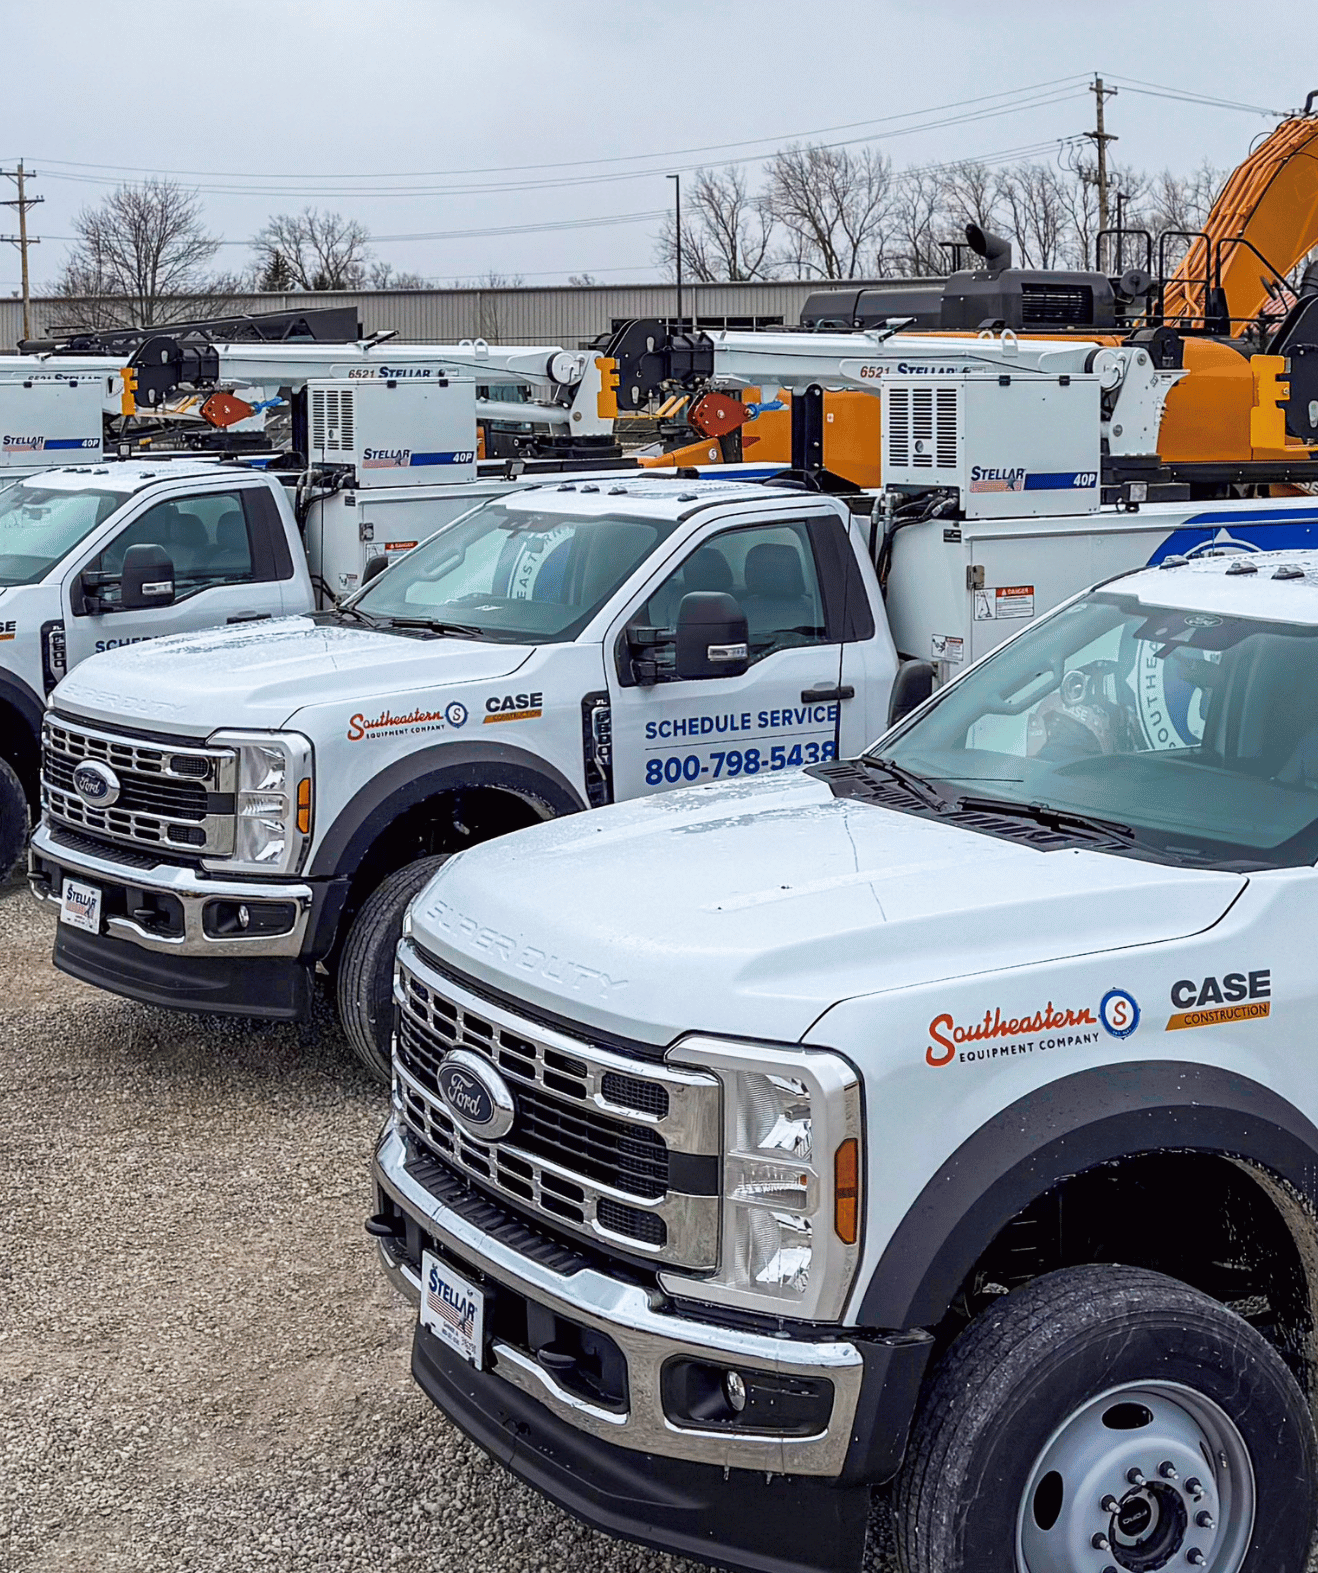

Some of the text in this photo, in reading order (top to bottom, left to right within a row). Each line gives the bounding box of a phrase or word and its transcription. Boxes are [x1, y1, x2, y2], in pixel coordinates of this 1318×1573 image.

[348, 366, 431, 378] 6521 STELLAR
[860, 365, 890, 378] 6521
[3, 435, 99, 449] STELLAR 40P
[363, 448, 473, 462] STELLAR 40P
[971, 466, 1095, 487] STELLAR 40P
[485, 692, 543, 713] CASE
[347, 707, 444, 741] Southeastern
[366, 724, 445, 739] EQUIPMENT COMPANY
[645, 704, 838, 740] SCHEDULE SERVICE
[645, 740, 837, 786] 800-798-5438
[79, 773, 100, 794] Ford
[66, 886, 97, 907] STELLAR
[1170, 969, 1271, 1009] CASE
[1183, 1004, 1267, 1026] CONSTRUCTION
[925, 1001, 1097, 1067] Southeastern
[959, 1042, 1034, 1063] EQUIPMENT
[1038, 1033, 1100, 1051] COMPANY
[447, 1072, 482, 1117] Ford
[429, 1268, 475, 1322] STELLAR
